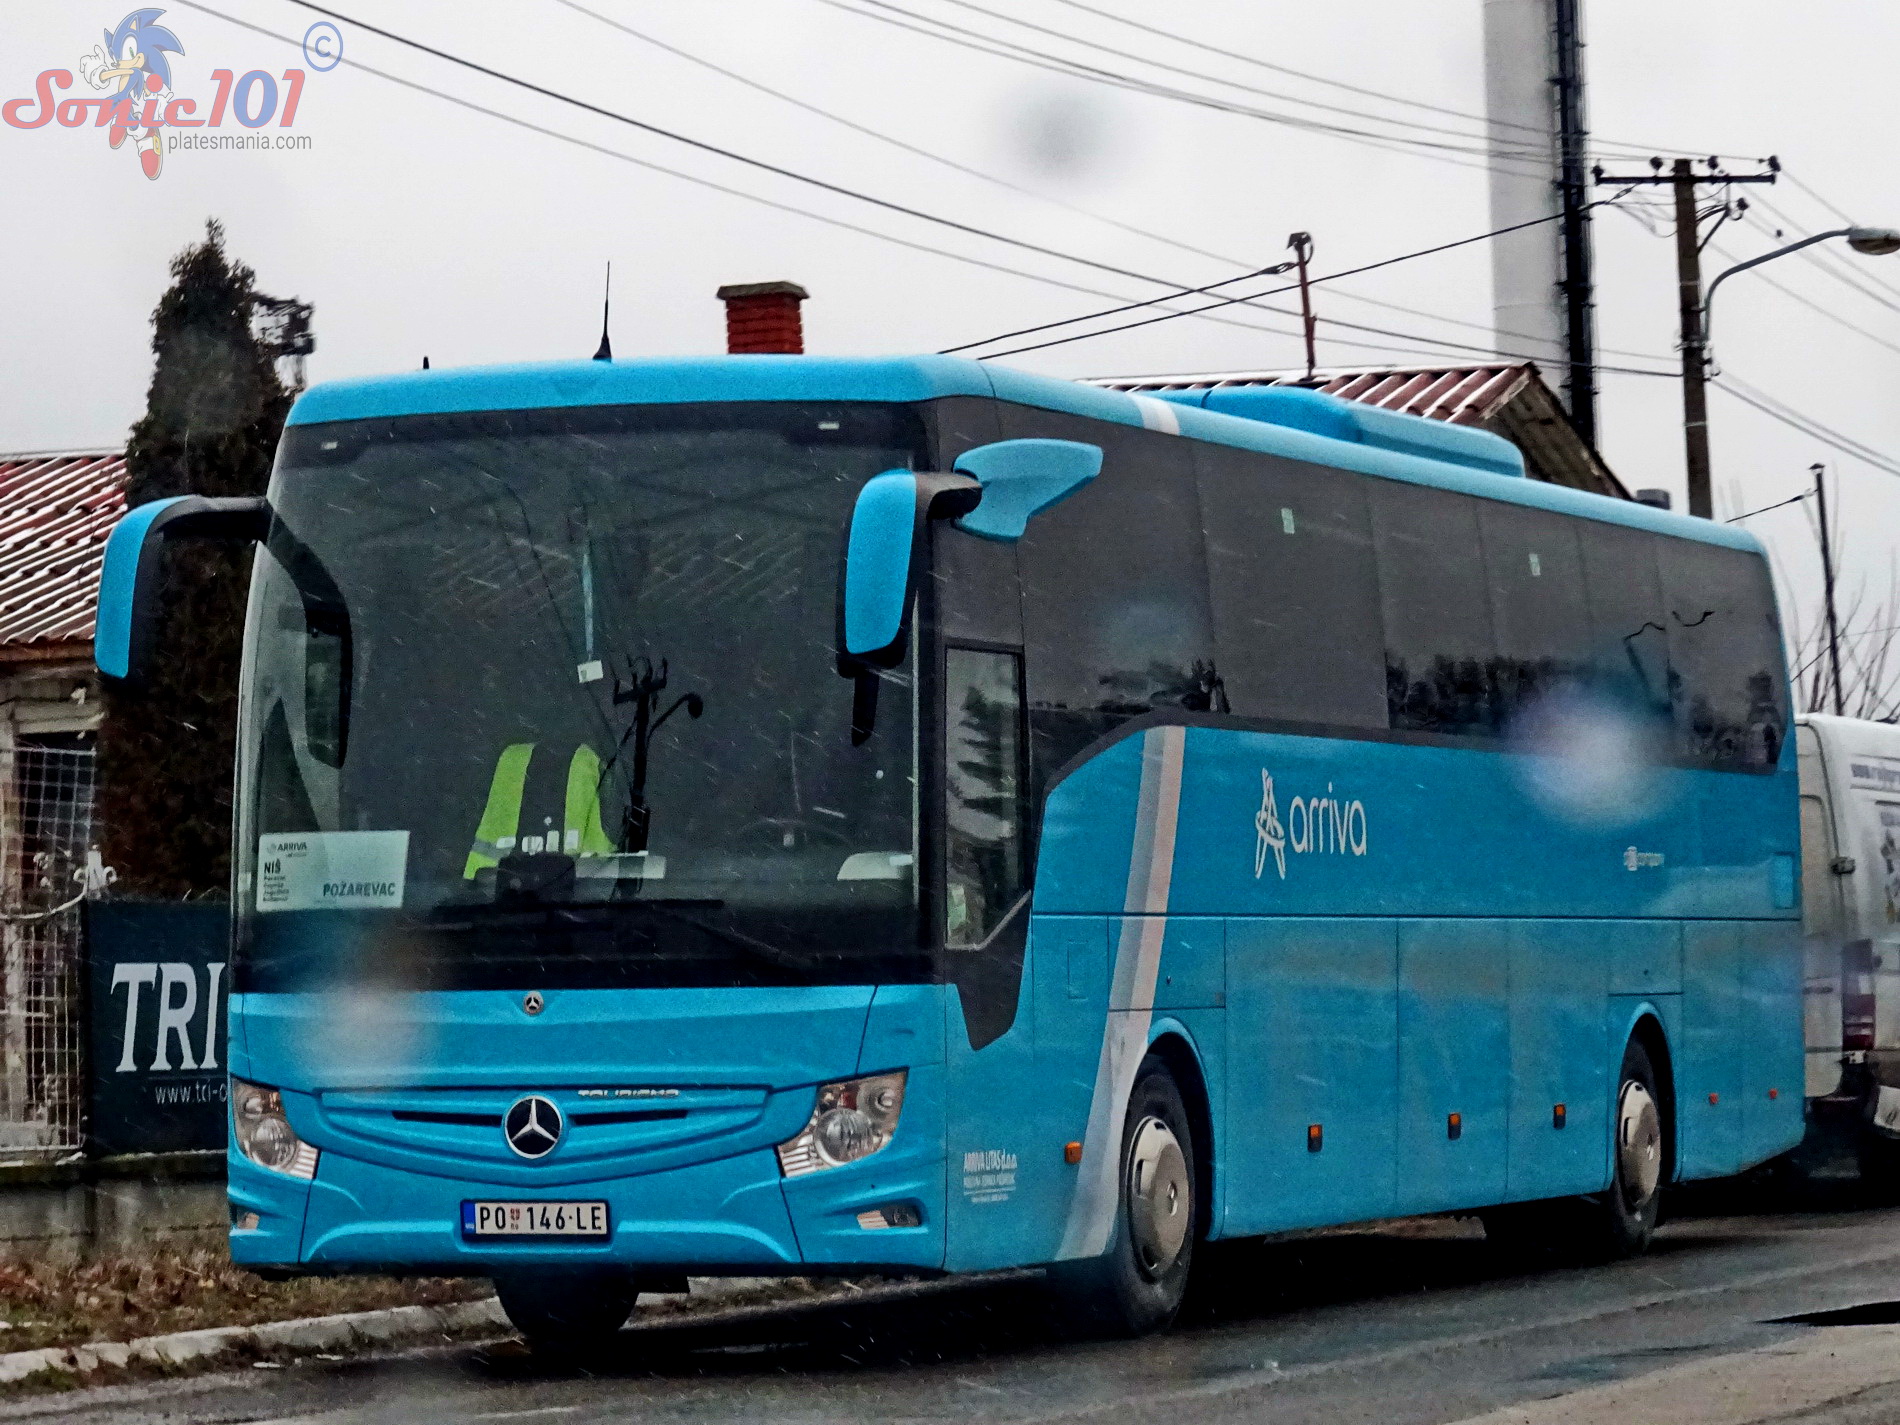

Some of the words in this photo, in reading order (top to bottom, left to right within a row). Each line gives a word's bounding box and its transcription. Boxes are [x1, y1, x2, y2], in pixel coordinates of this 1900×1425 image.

[1289, 781, 1367, 857] arriva
[263, 858, 282, 875] NIŠ
[322, 880, 397, 898] POŽAREVAC
[110, 962, 227, 1073] TRI
[479, 1205, 507, 1231] PO
